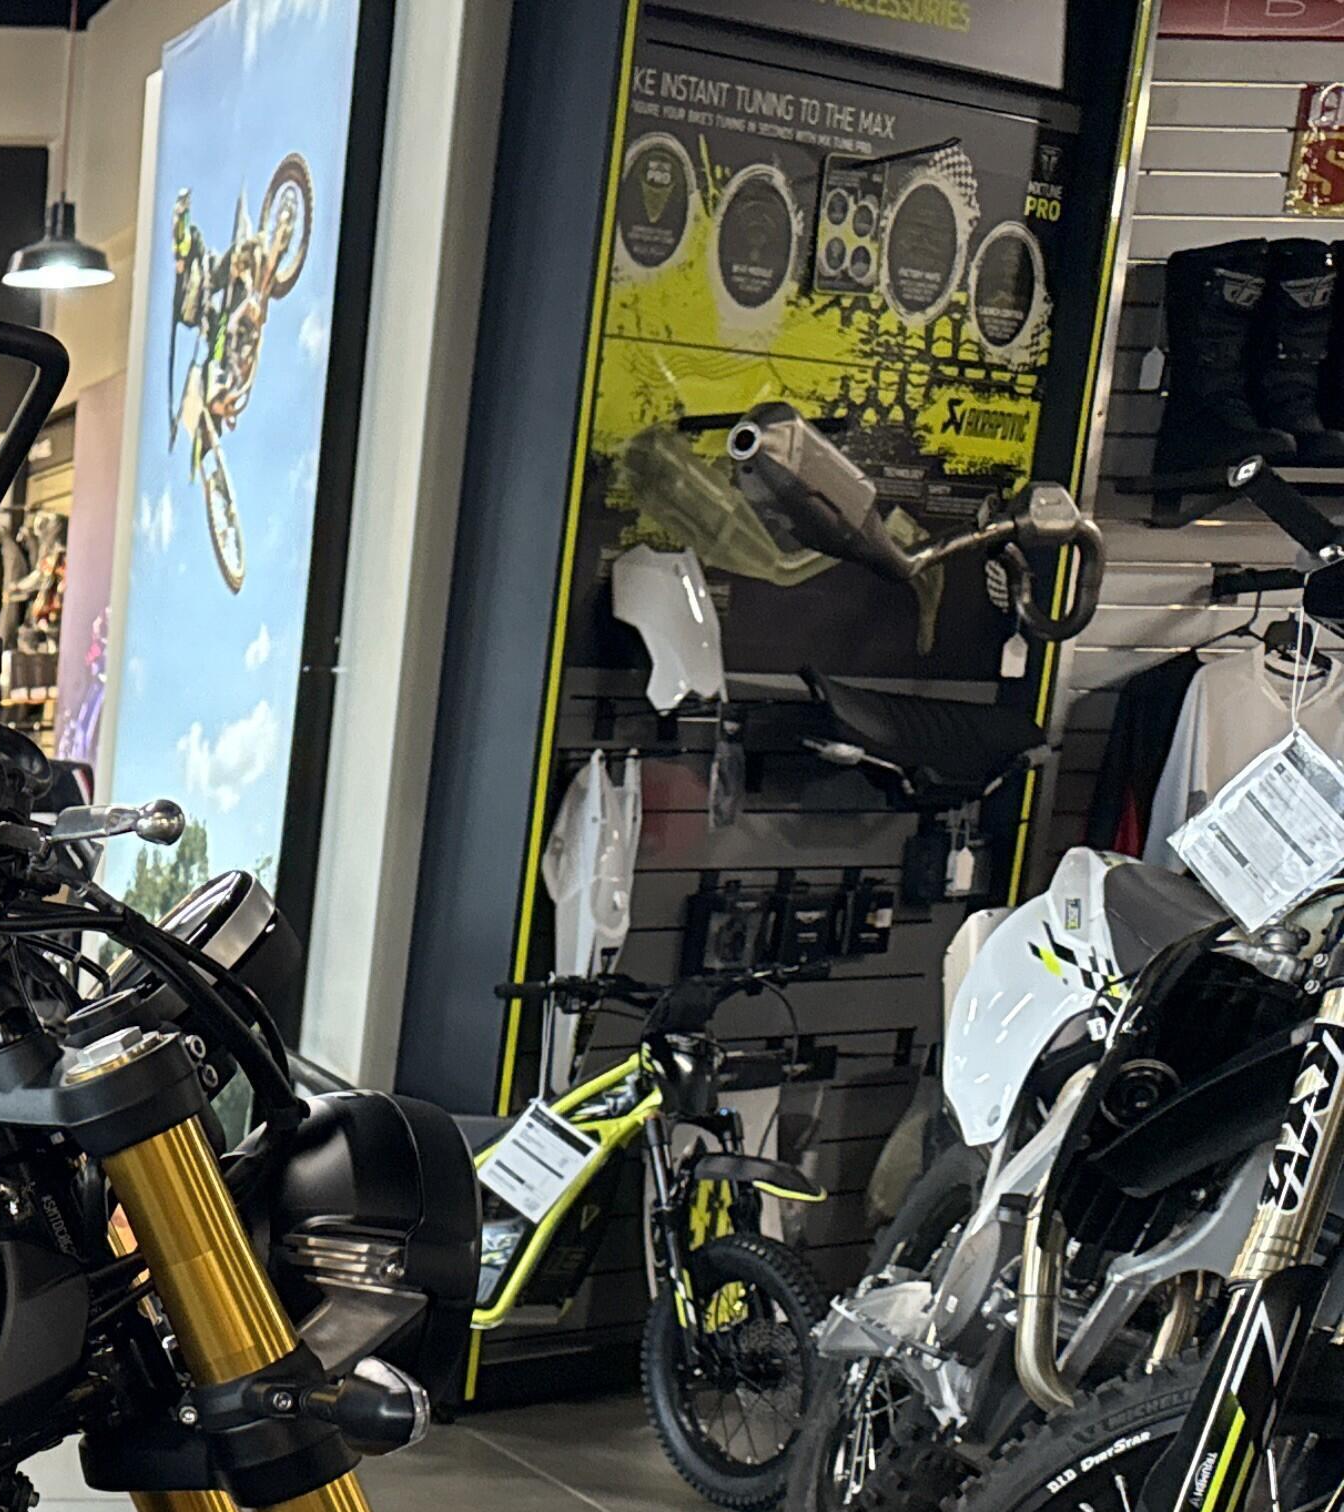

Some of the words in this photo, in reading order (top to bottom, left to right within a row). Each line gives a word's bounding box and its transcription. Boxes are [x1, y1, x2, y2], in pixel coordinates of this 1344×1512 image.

[660, 72, 730, 107] INSTANT
[735, 85, 795, 121] TUNING
[799, 97, 821, 126] TO
[825, 103, 856, 132] THE
[858, 109, 897, 141] MAX
[1024, 196, 1061, 222] PRO
